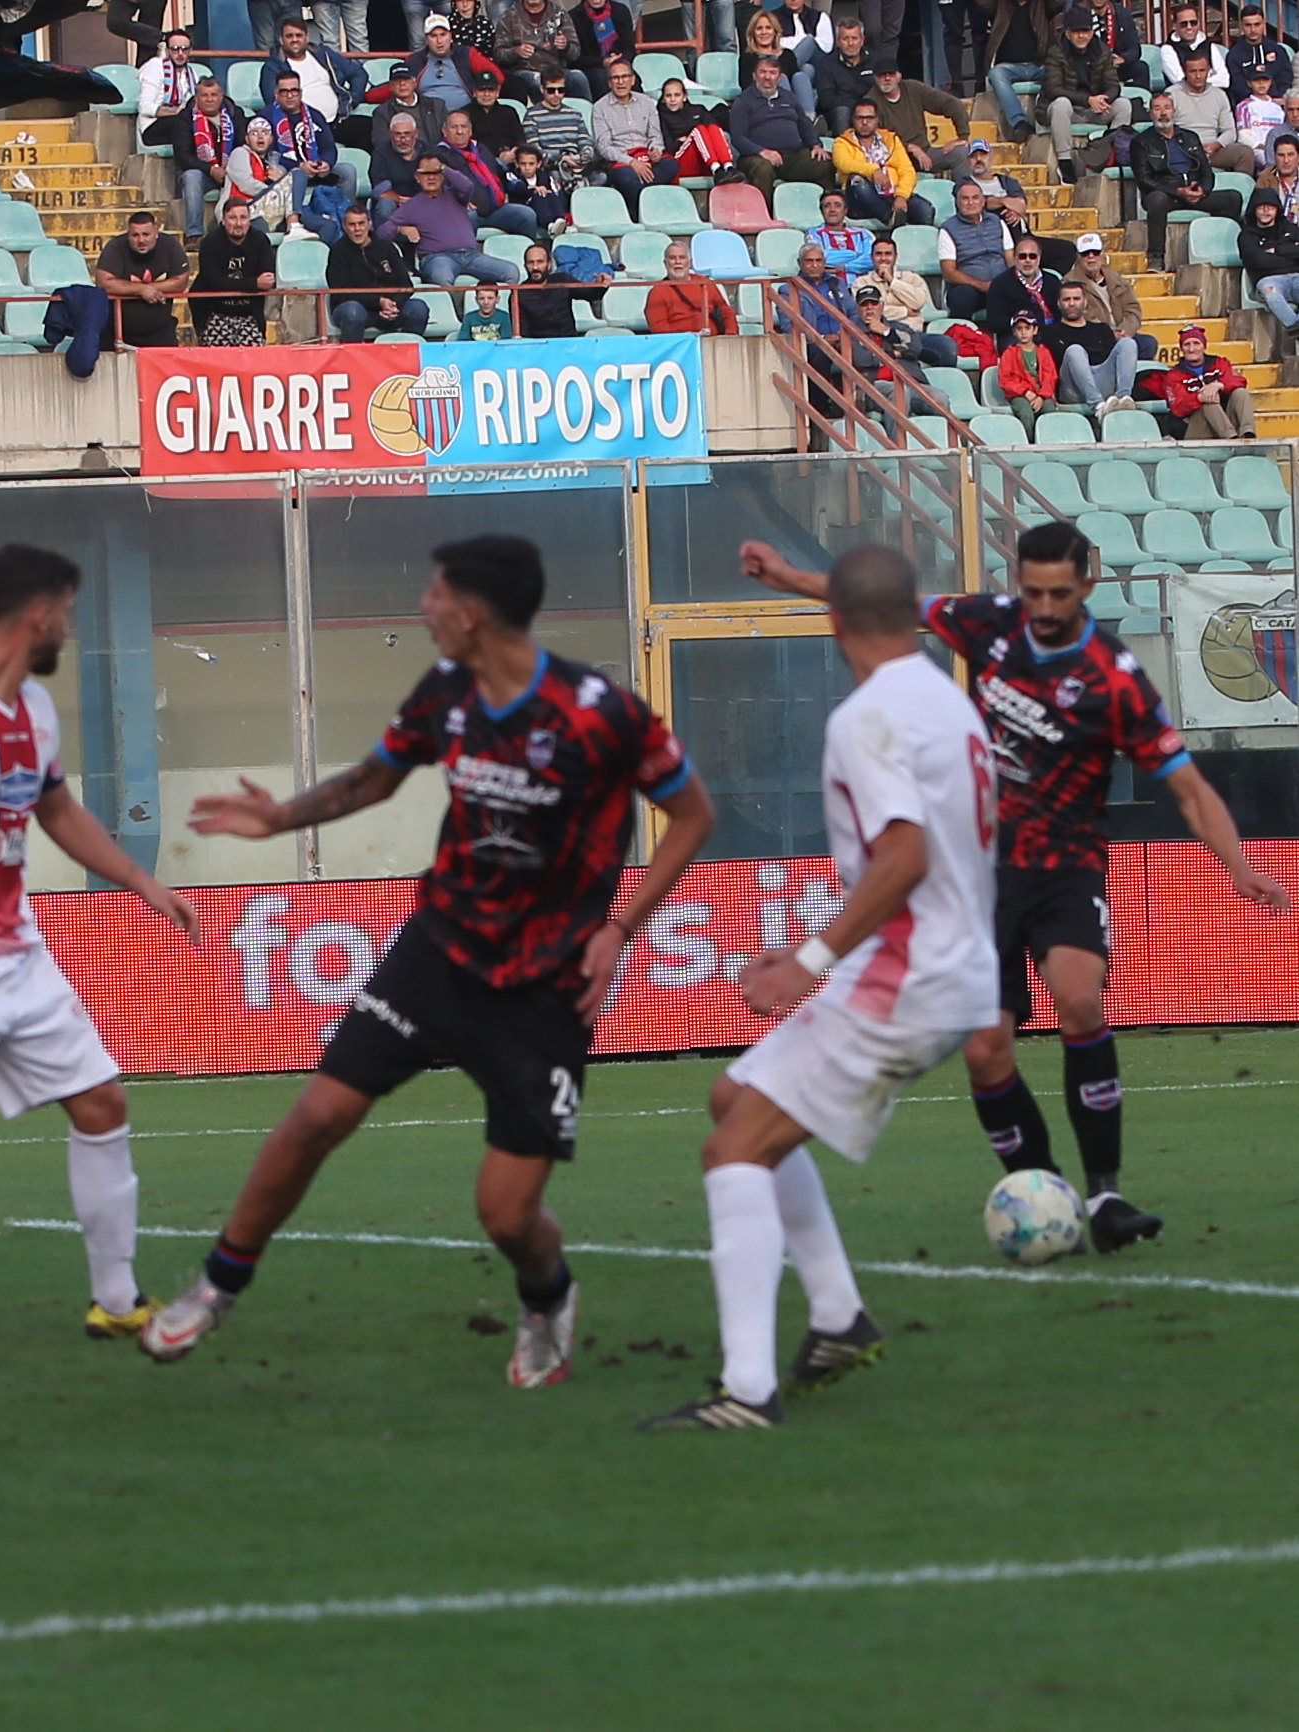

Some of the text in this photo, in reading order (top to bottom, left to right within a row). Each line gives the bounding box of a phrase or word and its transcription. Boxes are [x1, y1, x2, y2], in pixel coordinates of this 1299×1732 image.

[19, 147, 37, 164] 13
[70, 190, 87, 206] 12
[155, 373, 353, 453] GIARRE
[473, 360, 688, 445] RIPOSTO
